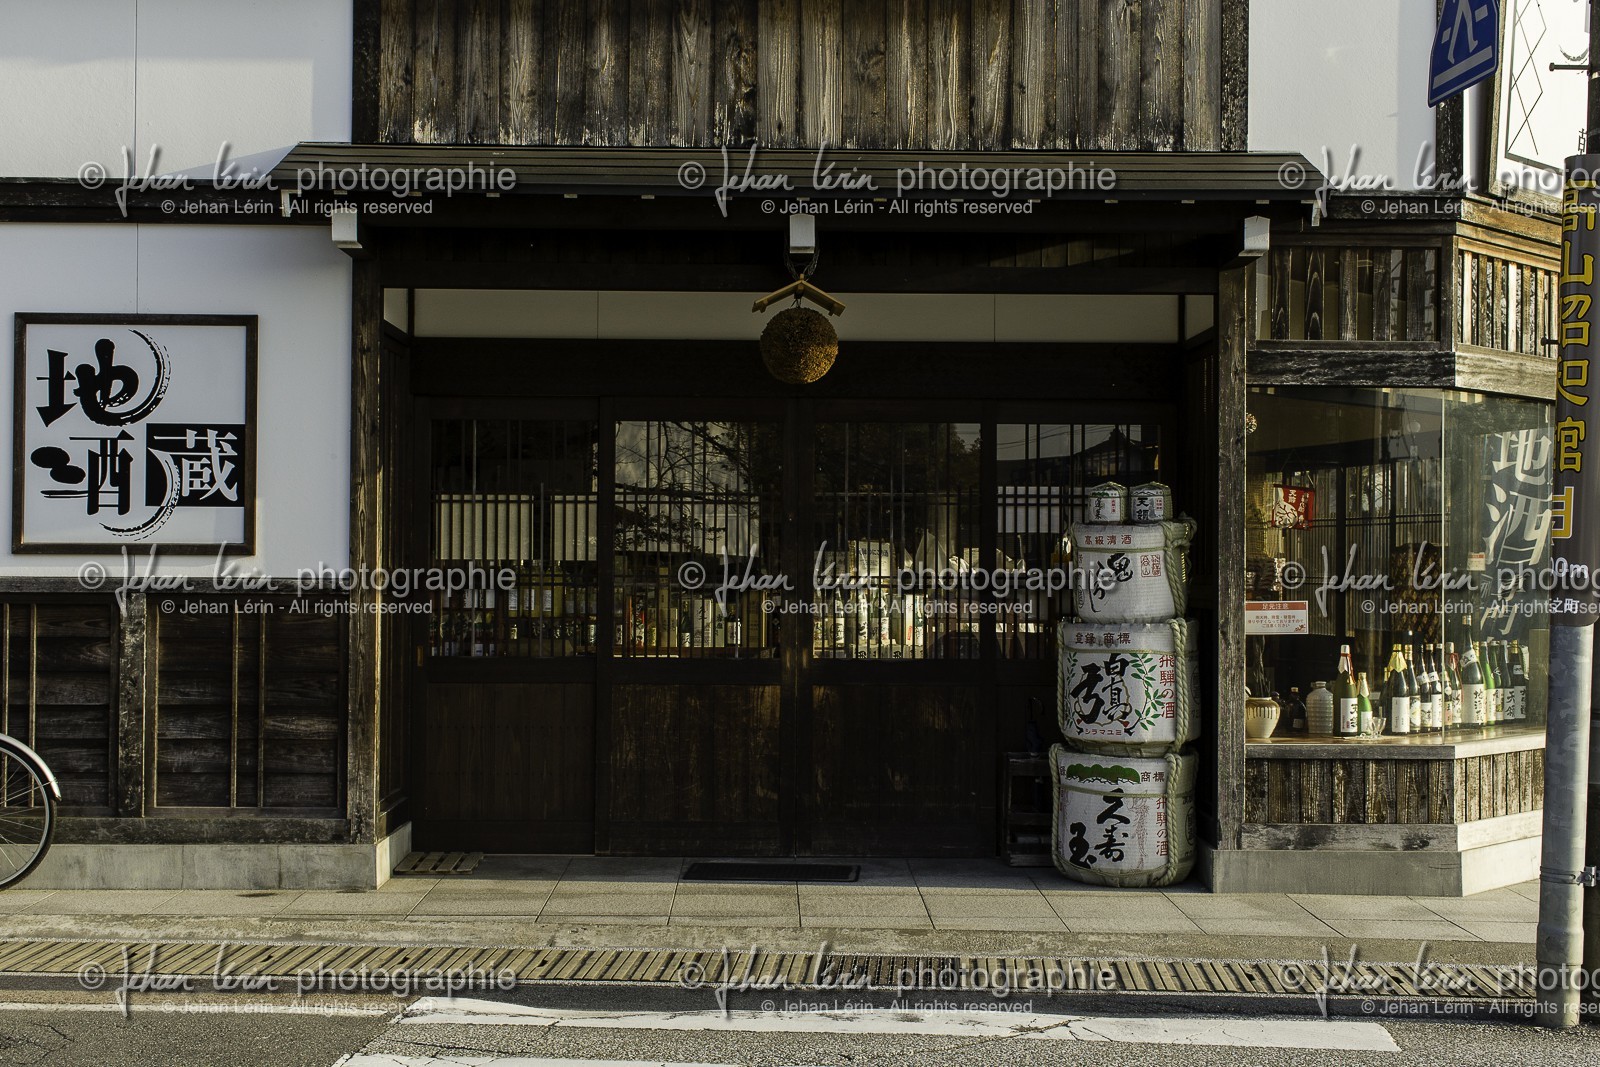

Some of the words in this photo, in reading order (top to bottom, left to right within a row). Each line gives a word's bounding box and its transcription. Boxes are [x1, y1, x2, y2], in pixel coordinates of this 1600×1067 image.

[1549, 597, 1580, 614] 之町
[1158, 654, 1175, 719] 飛騨の酒
[1085, 728, 1122, 736] シラマユミ
